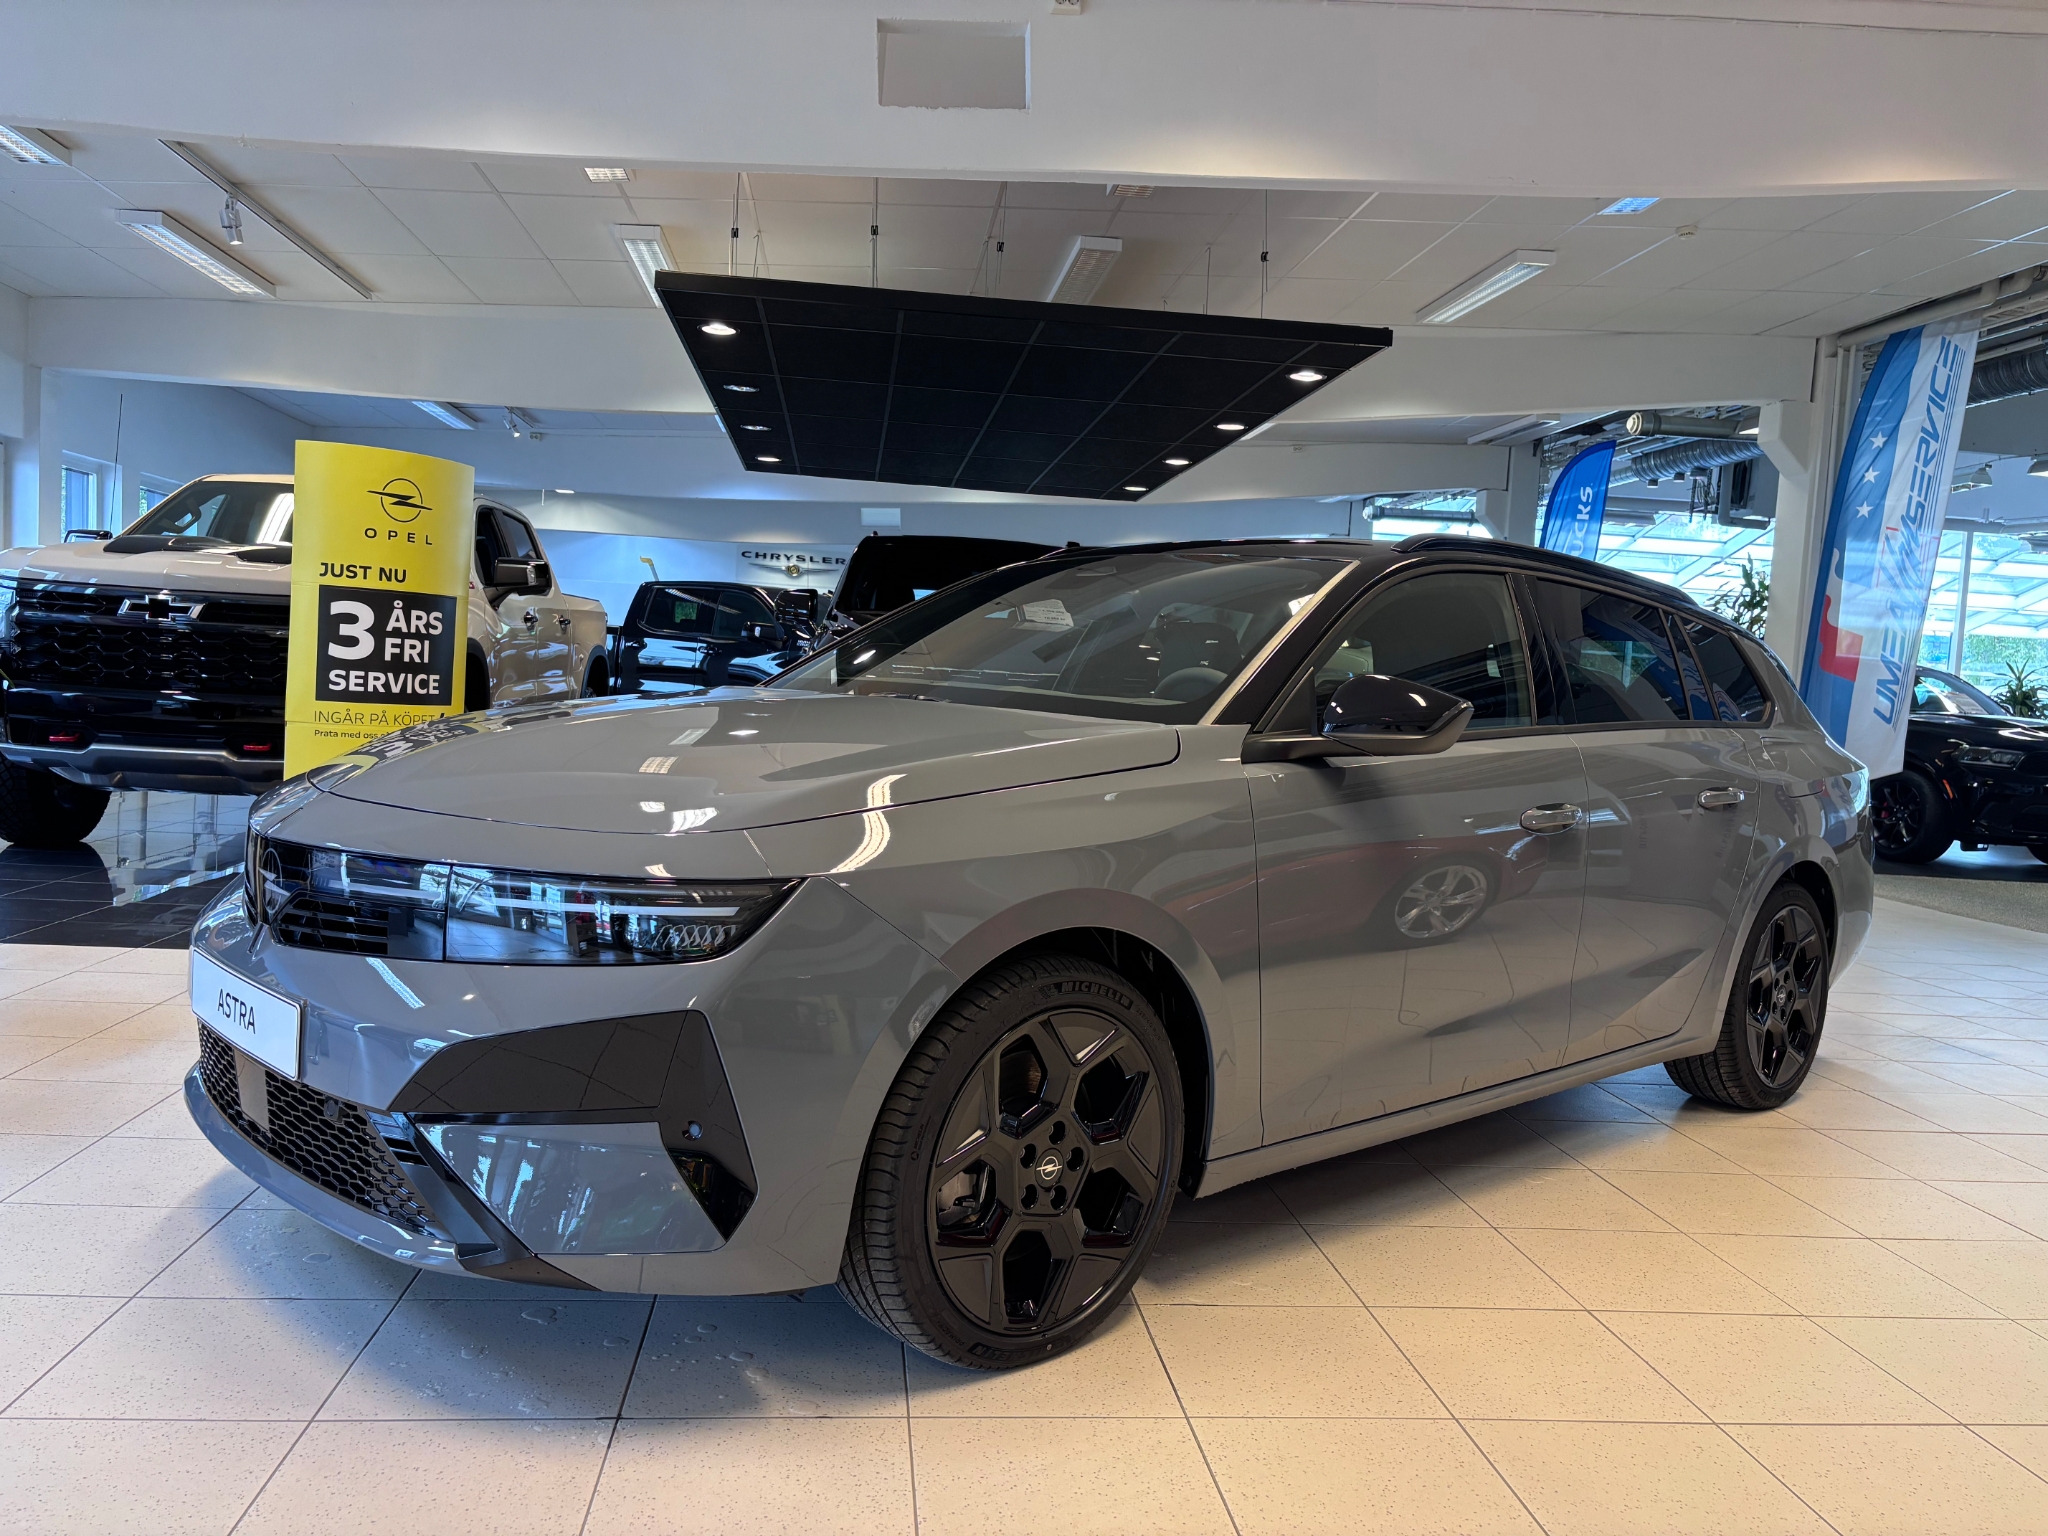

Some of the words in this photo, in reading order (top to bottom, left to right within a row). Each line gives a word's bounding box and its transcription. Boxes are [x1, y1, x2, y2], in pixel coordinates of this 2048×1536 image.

[364, 527, 433, 545] OPEL
[741, 551, 846, 565] CHRYSLER
[319, 562, 372, 580] JUST
[378, 567, 407, 583] NU
[327, 600, 375, 660] 3
[385, 600, 443, 635] ÅRS
[384, 637, 430, 663] FRI
[328, 669, 440, 695] SERVICE
[314, 708, 365, 724] INGÅR
[369, 709, 389, 726] PÅ
[314, 729, 339, 738] Prata
[341, 730, 361, 739] med
[1061, 981, 1131, 1007] MICHELIN
[217, 988, 256, 1035] ASTRA
